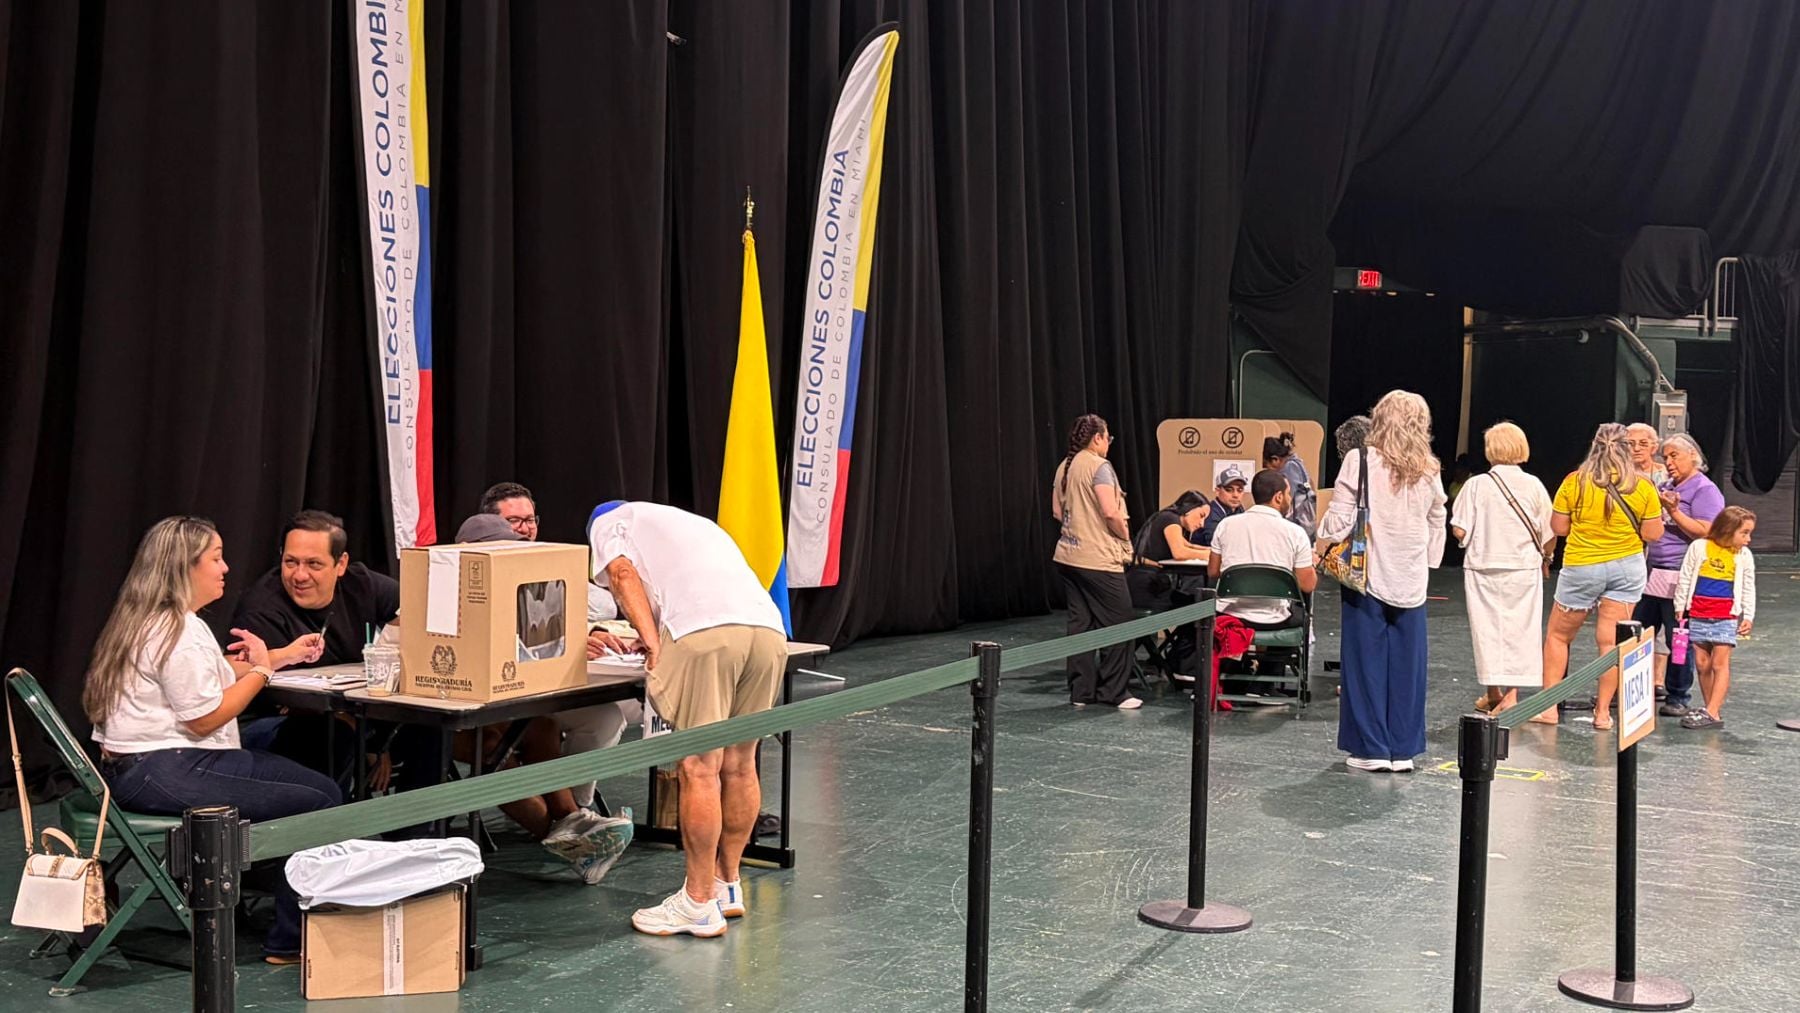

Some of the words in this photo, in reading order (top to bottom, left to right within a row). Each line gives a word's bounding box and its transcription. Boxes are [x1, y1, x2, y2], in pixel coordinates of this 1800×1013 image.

[395, 31, 404, 64] EN
[396, 83, 410, 230] COLOMBIA
[852, 119, 867, 181] MIAMI
[849, 193, 858, 219] EN
[402, 248, 413, 280] DE
[834, 232, 854, 342] COLOMBIA
[1361, 271, 1380, 287] EXIT
[378, 190, 401, 424] ELECCIONES
[797, 309, 830, 488] ELECCIONES
[818, 149, 849, 300] COLOMBIA
[831, 354, 842, 380] DE
[817, 393, 838, 524] CONSULADO
[1624, 671, 1645, 712] MESA
